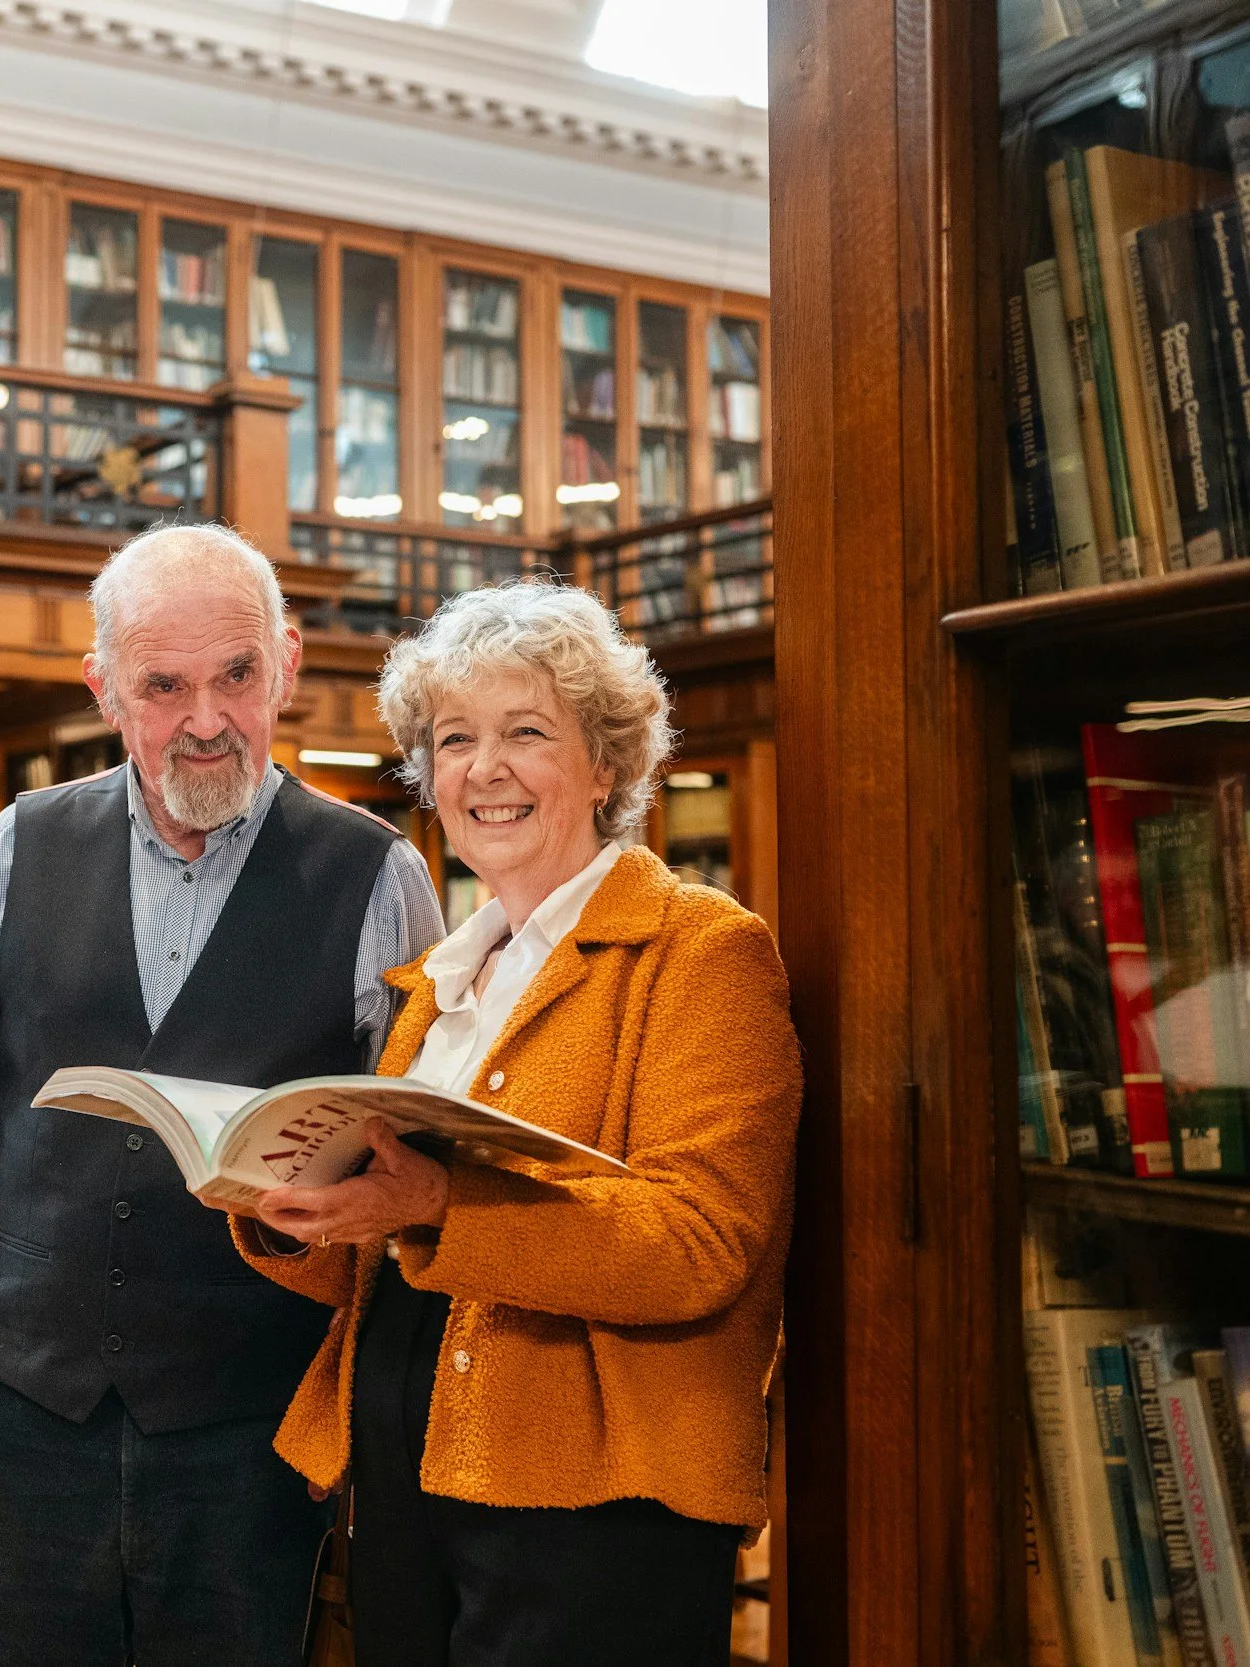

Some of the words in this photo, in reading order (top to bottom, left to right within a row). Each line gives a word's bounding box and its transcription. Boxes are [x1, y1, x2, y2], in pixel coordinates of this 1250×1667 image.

[1008, 295, 1028, 393] CONSTRUCTION
[1019, 395, 1038, 469] MATERIALS
[1161, 327, 1182, 412] Handbook
[1174, 322, 1194, 400] Concrete
[1184, 400, 1209, 511] Construction
[261, 1099, 350, 1180] ART
[284, 1115, 363, 1185] SCHOOL
[1137, 1353, 1157, 1390] FROM
[1140, 1392, 1168, 1440] FURY
[1154, 1462, 1195, 1569] PHANTOM
[1167, 1397, 1199, 1489] MECHANICS
[1188, 1493, 1206, 1516] OF
[1197, 1519, 1219, 1574] FLIGHT
